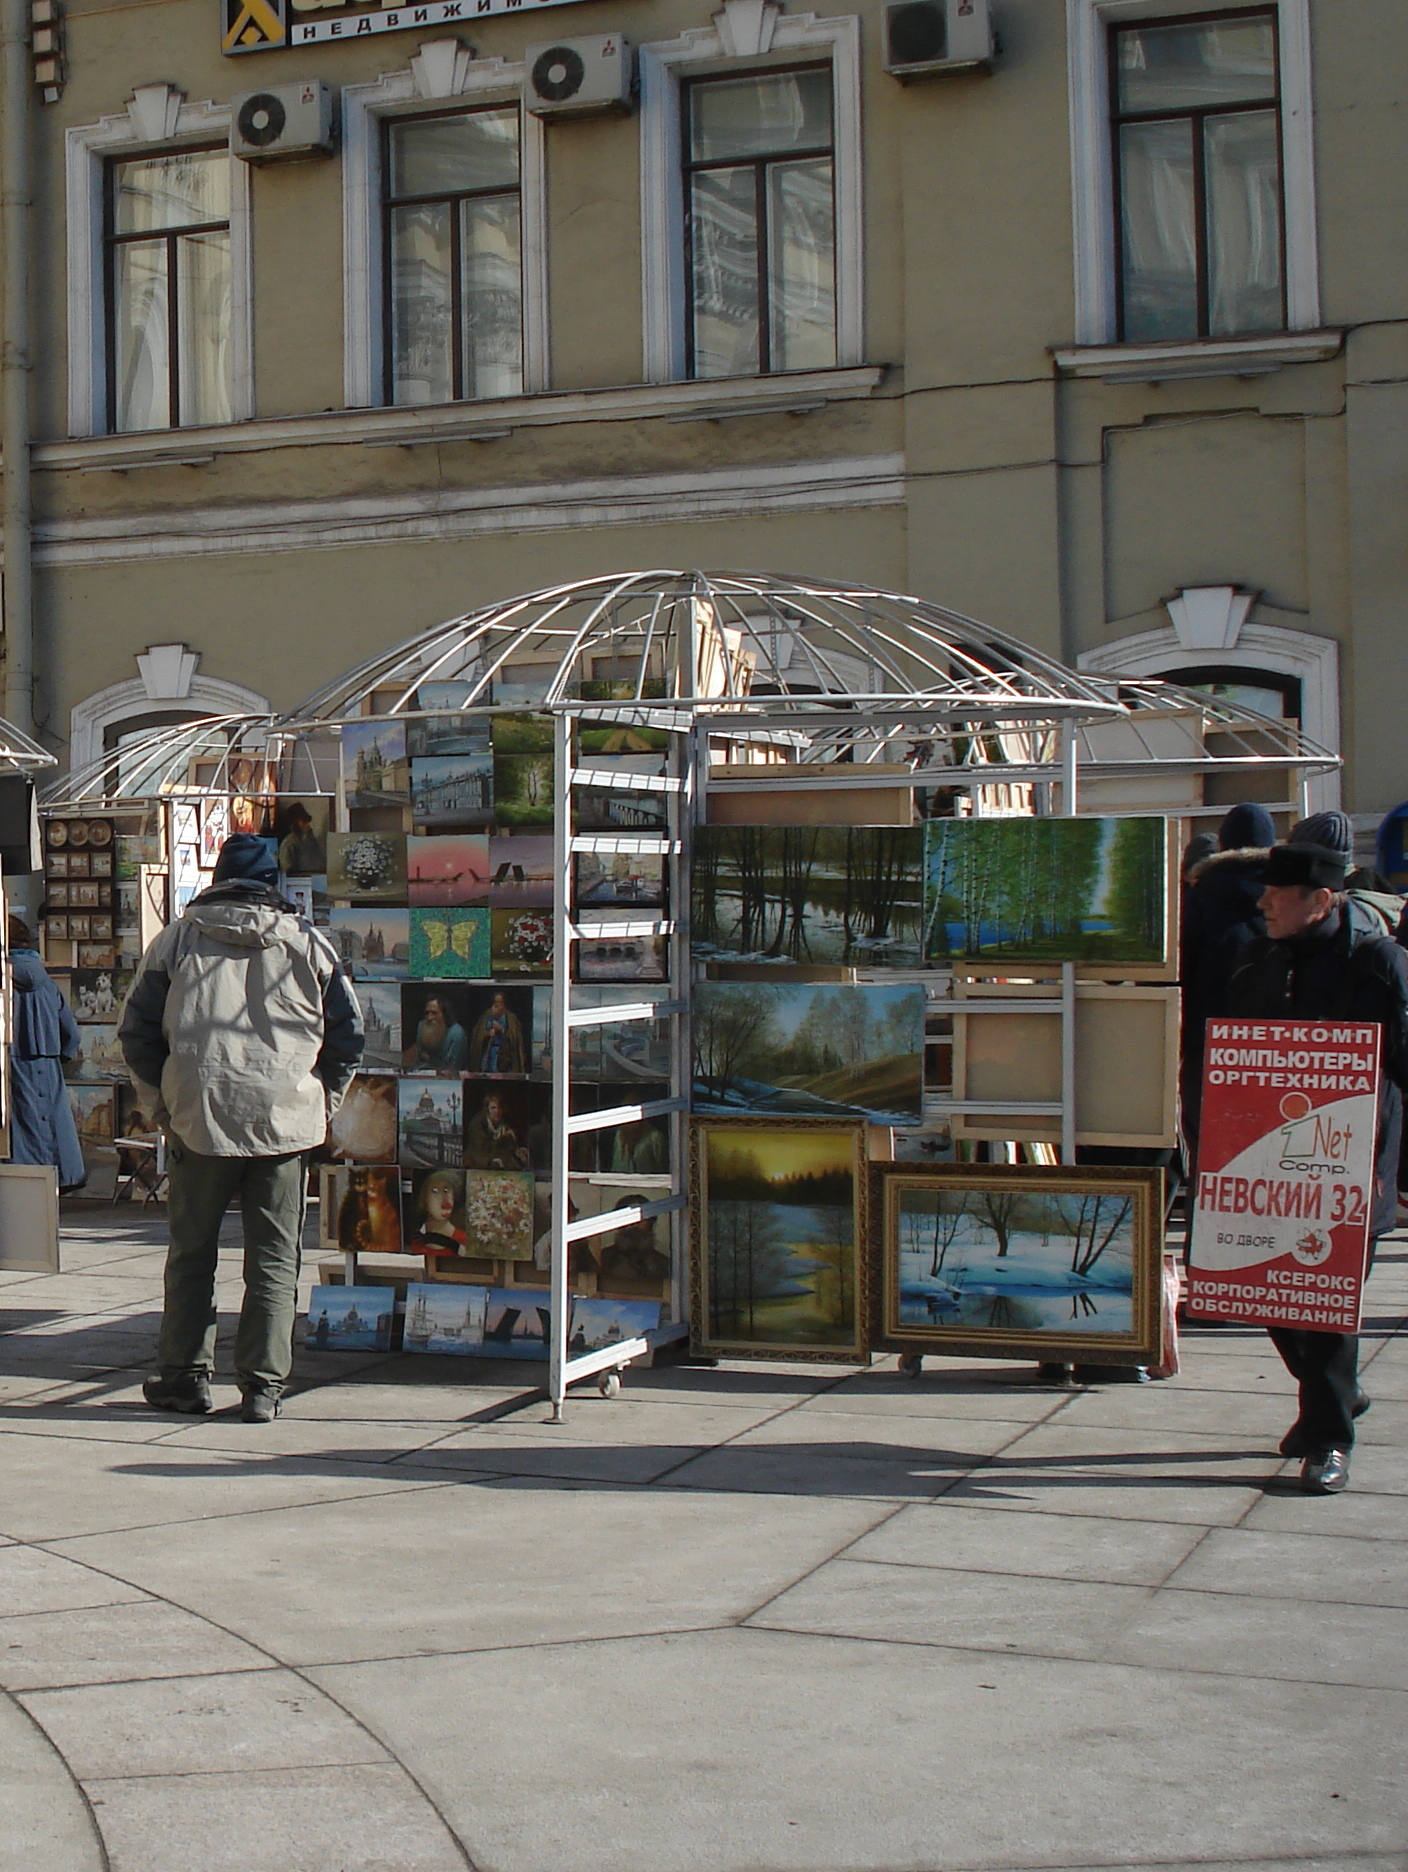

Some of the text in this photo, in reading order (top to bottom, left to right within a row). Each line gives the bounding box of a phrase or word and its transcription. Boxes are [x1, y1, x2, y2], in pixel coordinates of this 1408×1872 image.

[303, 0, 550, 39] НЕДВИЖИМ
[1209, 1047, 1374, 1071] КОМПЬЮТЕРЫ
[1208, 1070, 1371, 1091] ОРГТЕХНИКА
[1279, 1159, 1350, 1175] Comp.
[1199, 1174, 1363, 1223] НЕВСКИЙ 32
[1217, 1232, 1277, 1249] ВО ДВОРЕ
[1266, 1269, 1356, 1291] КСЕРОКС
[1192, 1280, 1356, 1310] КОРПОРАТИВНОЕ
[1191, 1297, 1355, 1326] ОБСЛУЖИВАНИЕ
